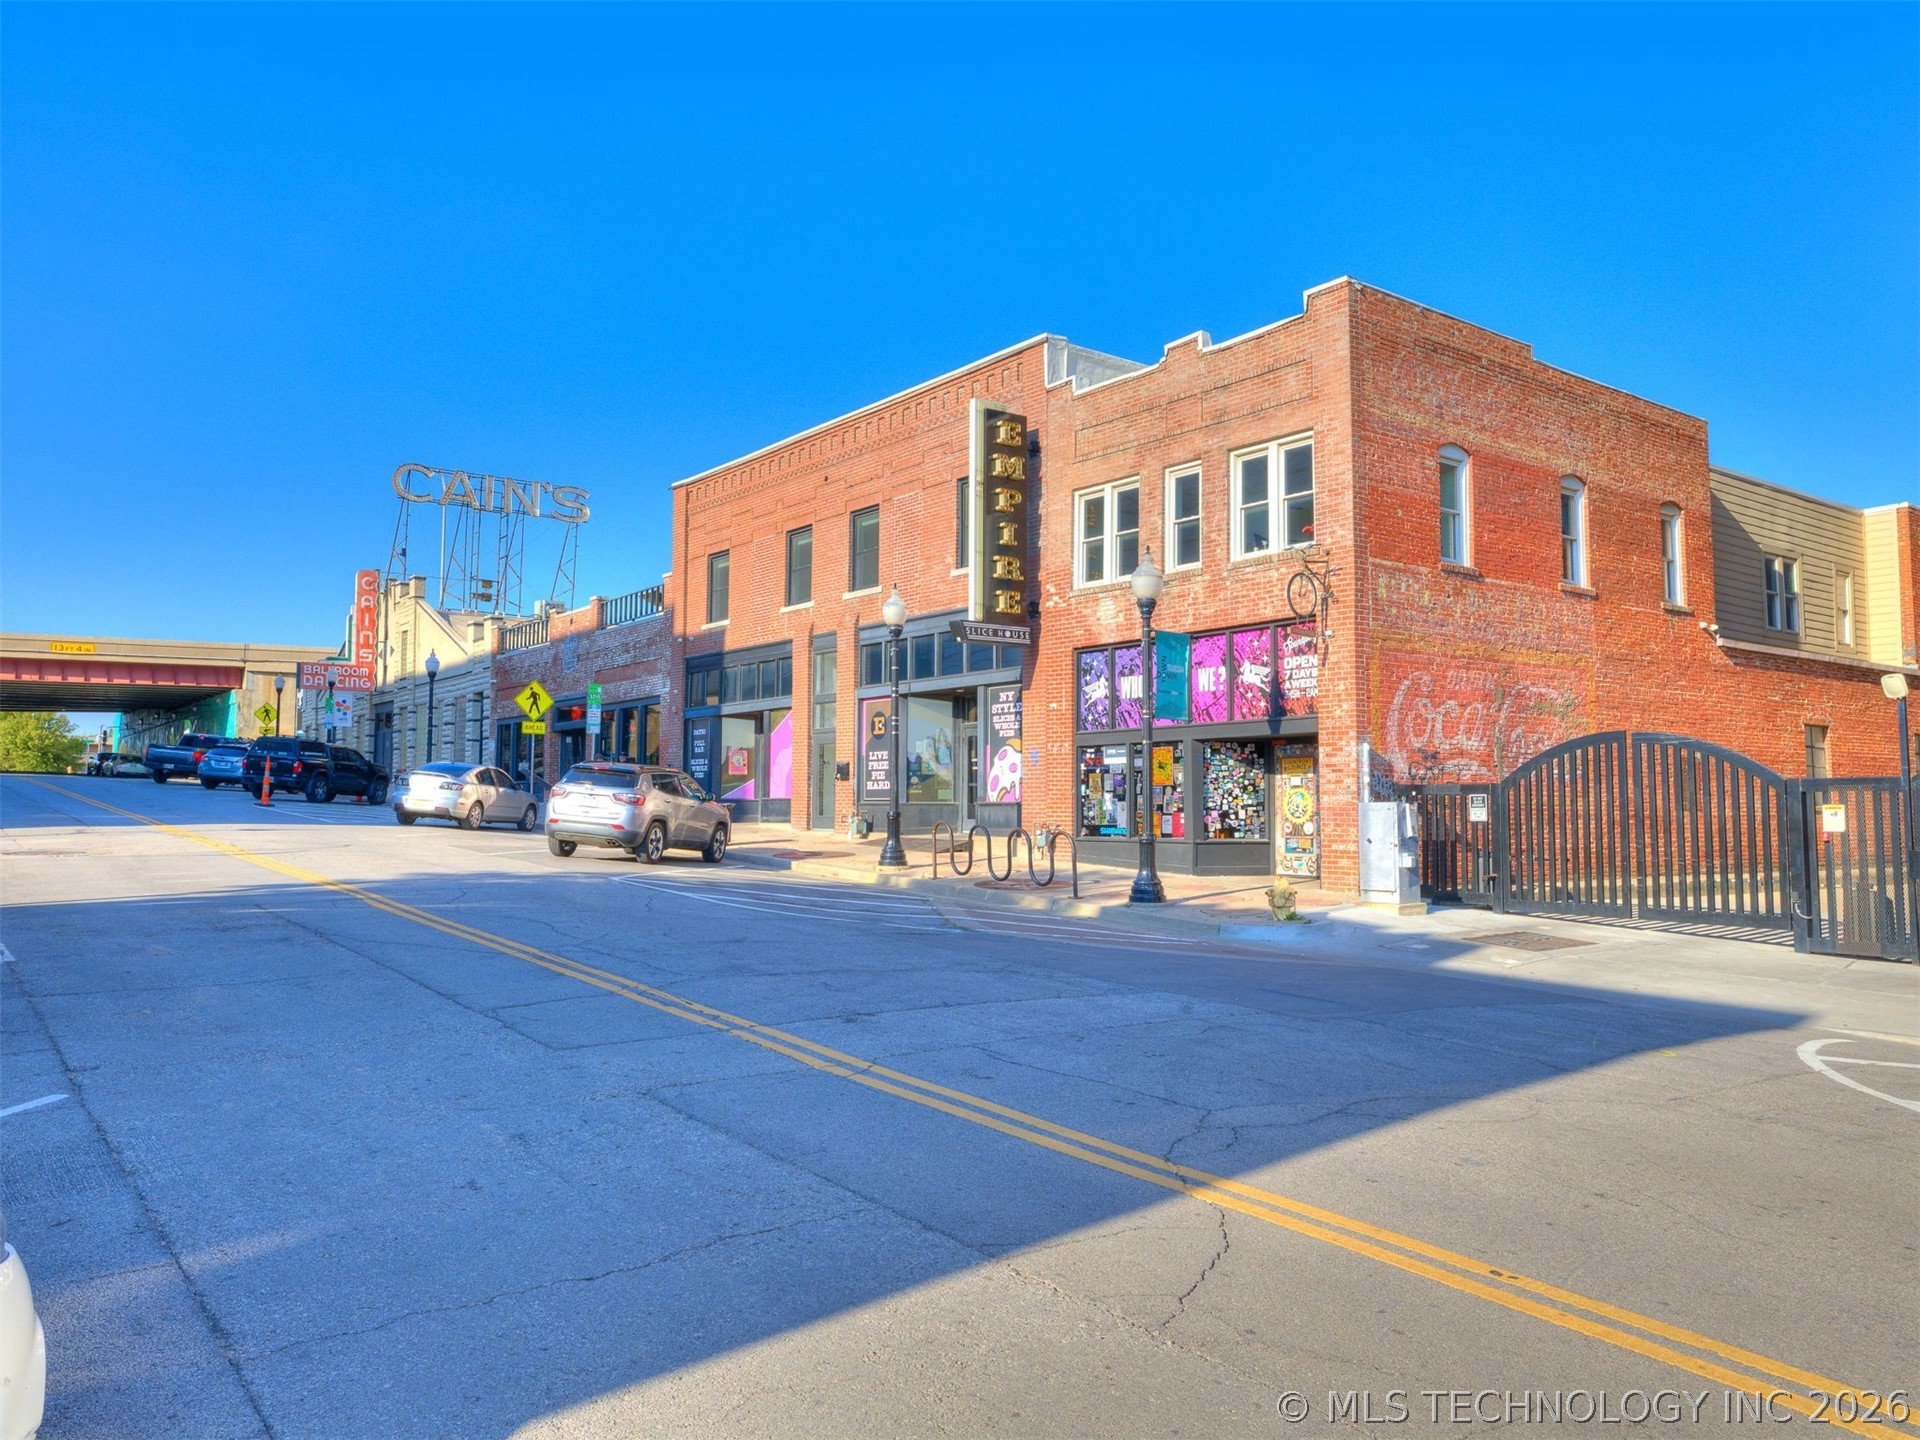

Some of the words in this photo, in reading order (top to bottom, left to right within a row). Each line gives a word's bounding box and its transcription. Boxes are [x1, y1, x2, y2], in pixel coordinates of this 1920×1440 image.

[392, 463, 590, 523] CAIN'S
[992, 420, 1025, 615] EMPIRE
[359, 576, 374, 662] CAINS
[965, 626, 993, 637] SLICE
[998, 629, 1030, 640] HOUSE
[1284, 654, 1318, 670] OPEN
[1284, 671, 1291, 680] 7
[1292, 667, 1318, 679] DAYS
[303, 675, 371, 688] DACING
[1284, 681, 1291, 690] A
[999, 691, 1015, 702] NY
[991, 702, 1022, 714] STYLE
[525, 723, 544, 731] AHEAD
[873, 716, 886, 735] E
[993, 721, 1021, 731] WHOLE
[869, 750, 889, 760] LIVE
[868, 761, 889, 771] FREE
[871, 771, 886, 780] PIE
[866, 781, 891, 791] HARD
